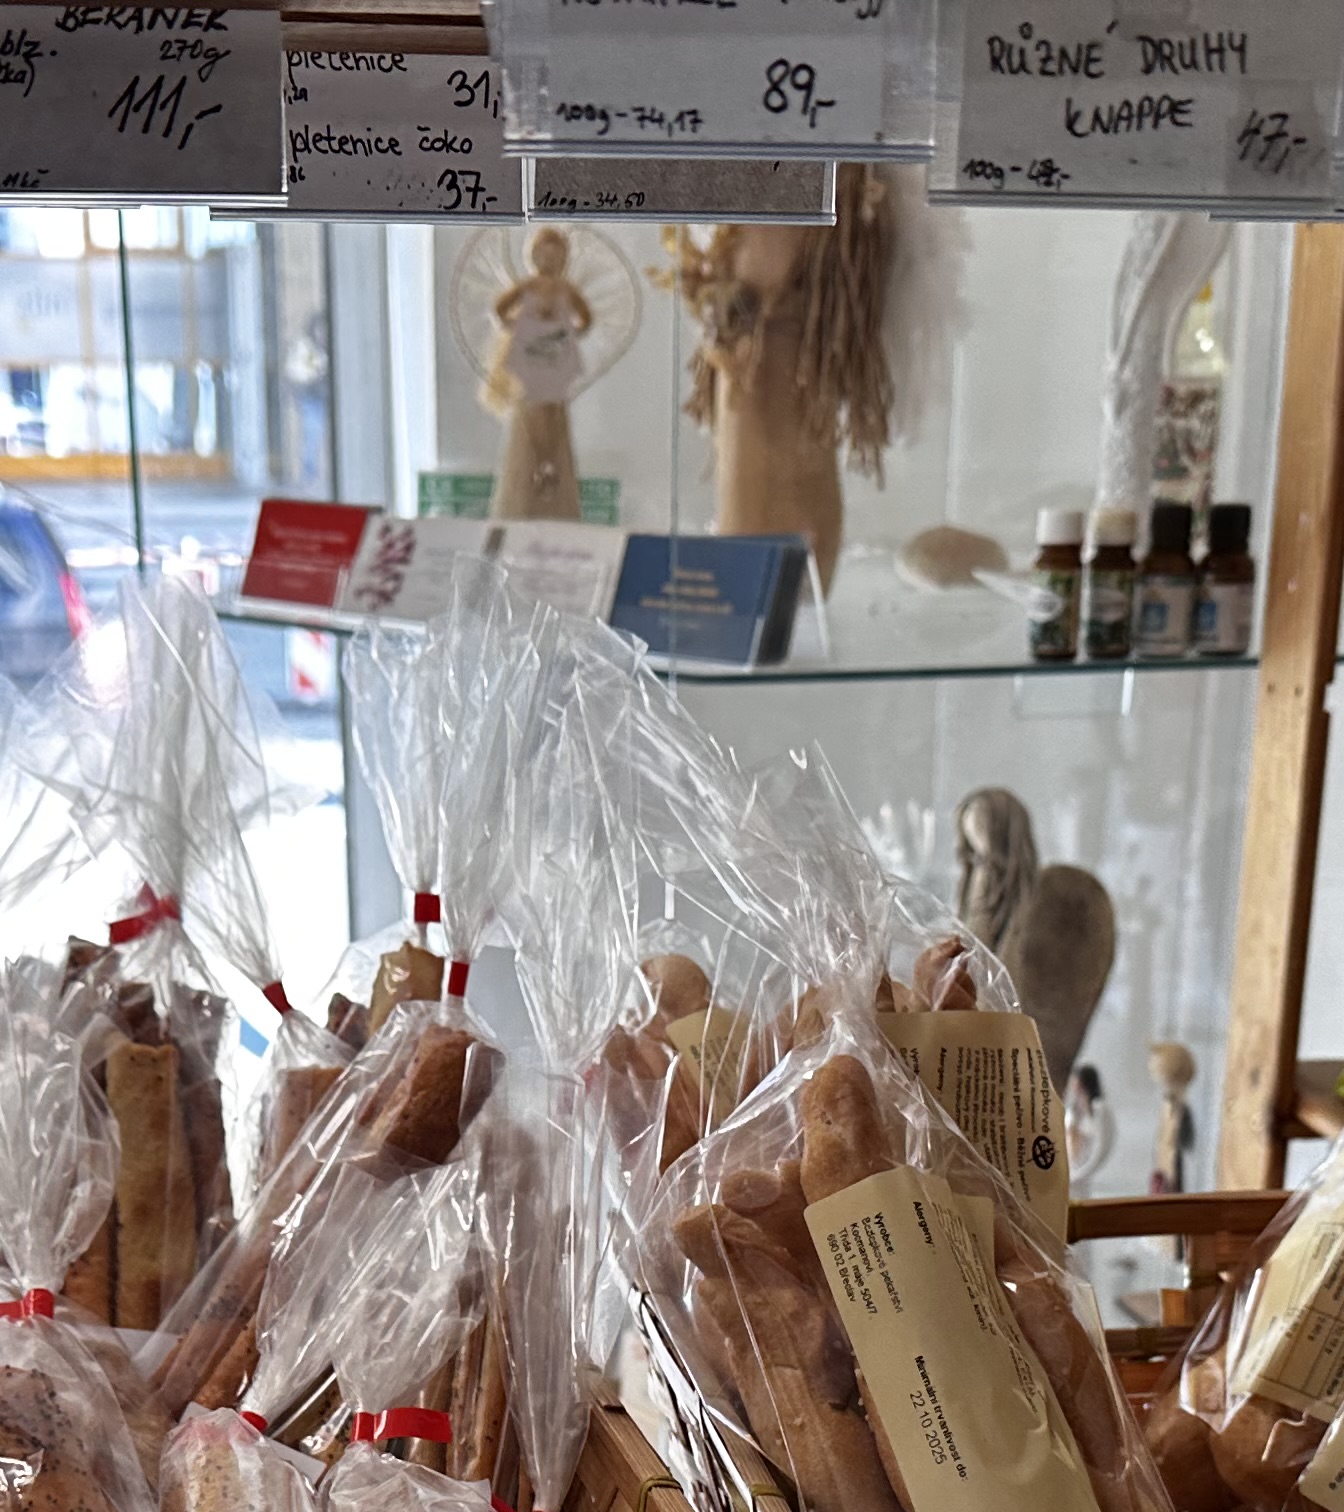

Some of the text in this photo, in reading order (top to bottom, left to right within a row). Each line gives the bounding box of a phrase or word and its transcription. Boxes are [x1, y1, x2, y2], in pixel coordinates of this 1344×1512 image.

[159, 39, 232, 82] 270g
[1136, 31, 1249, 76] DRUHY
[108, 75, 223, 150] 111,-
[762, 58, 836, 129] 89,-
[288, 125, 473, 163] pletenice čoko
[437, 168, 498, 212] 37,-
